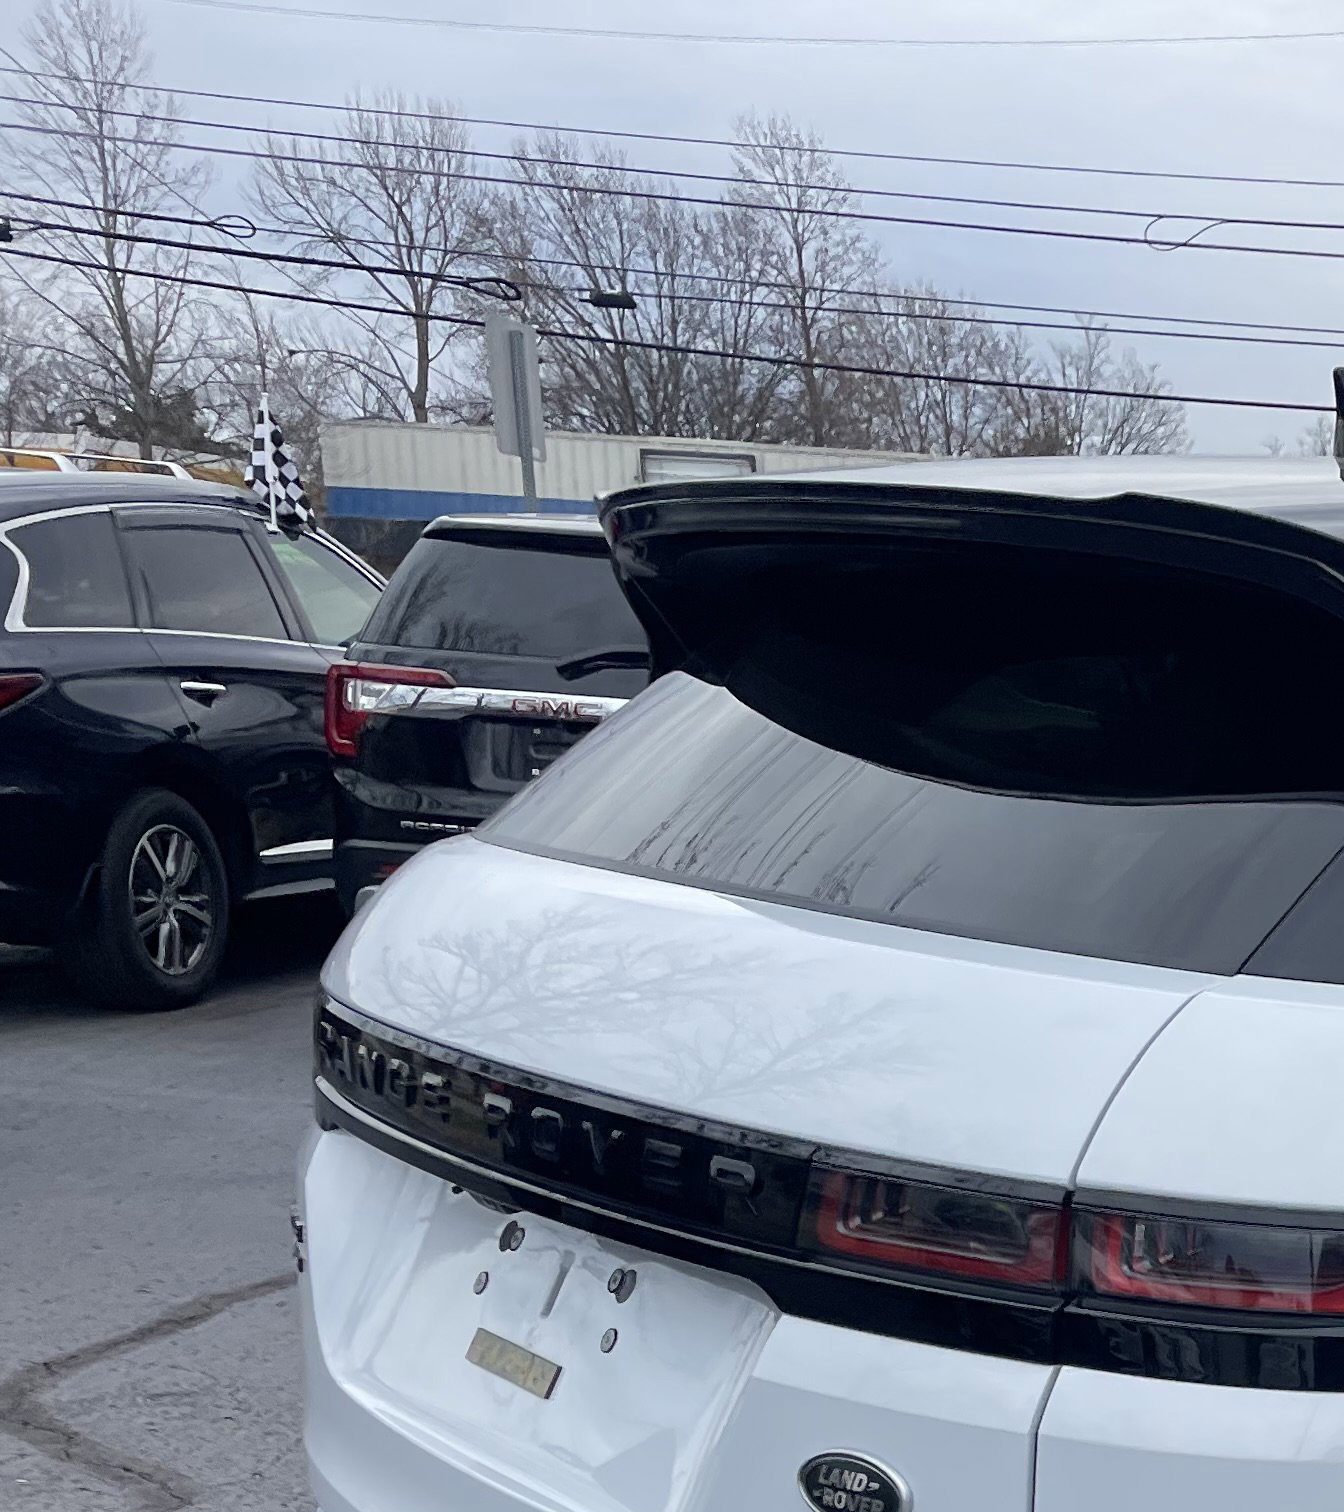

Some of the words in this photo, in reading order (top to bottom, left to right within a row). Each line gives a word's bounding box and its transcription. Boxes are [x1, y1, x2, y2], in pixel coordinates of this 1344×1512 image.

[511, 698, 604, 720] GMC
[318, 1021, 451, 1122] RANGE
[482, 1091, 765, 1217] ROVER
